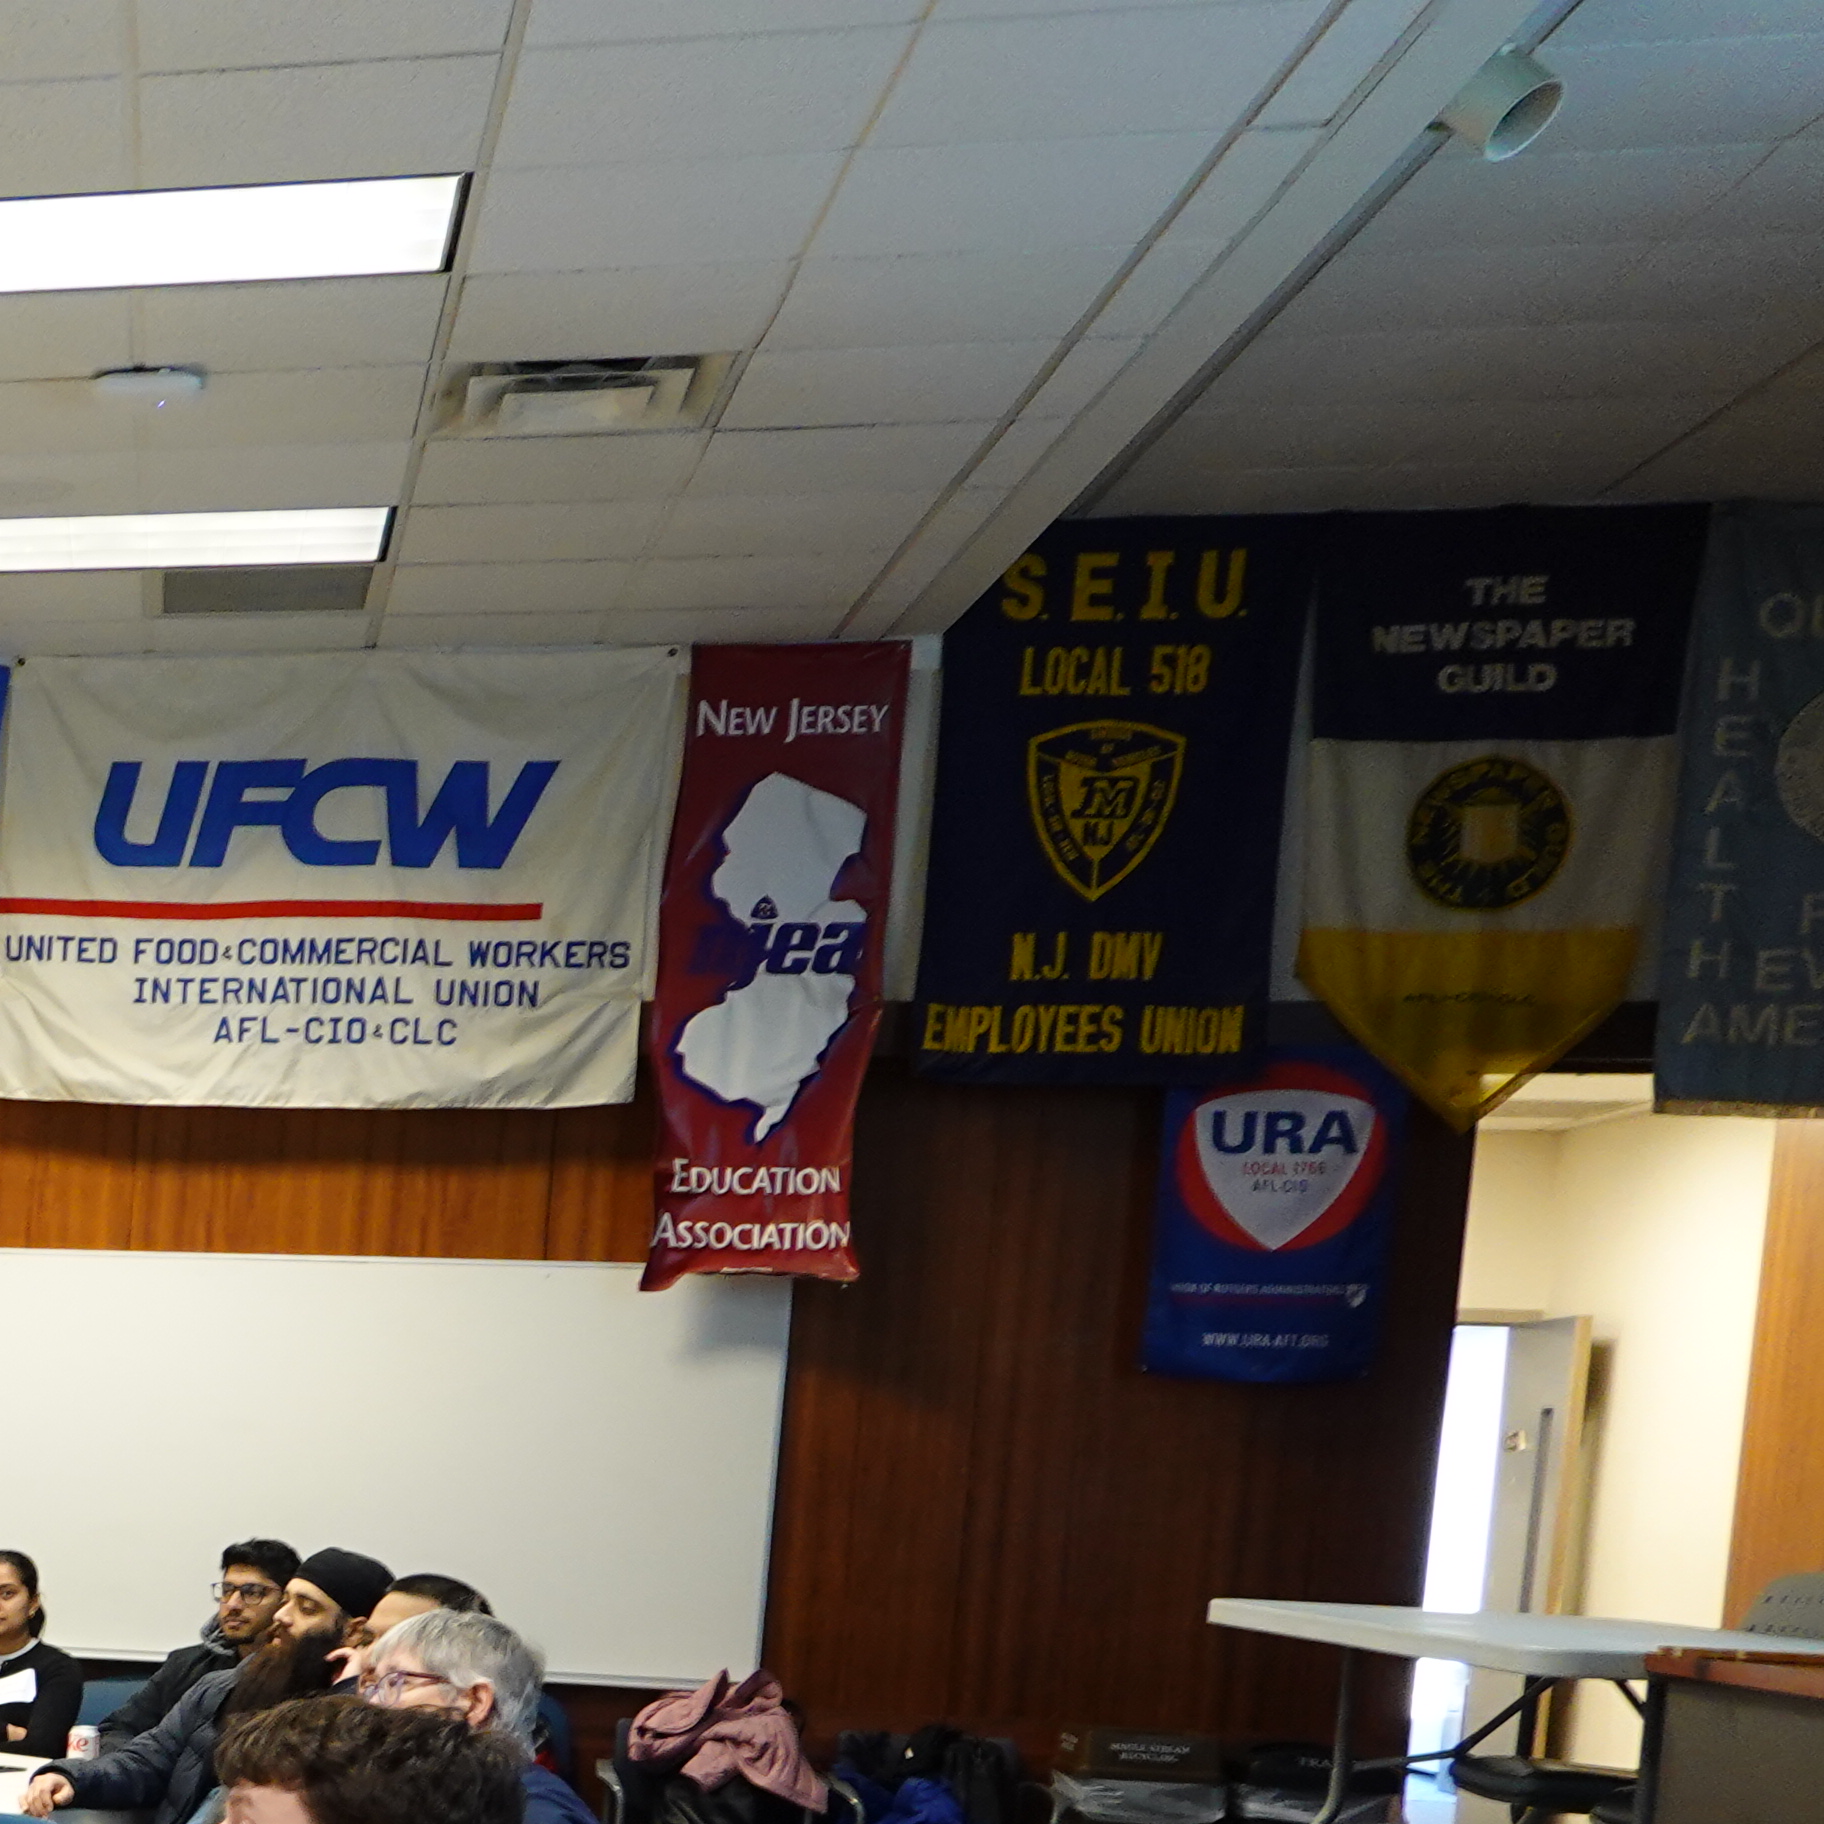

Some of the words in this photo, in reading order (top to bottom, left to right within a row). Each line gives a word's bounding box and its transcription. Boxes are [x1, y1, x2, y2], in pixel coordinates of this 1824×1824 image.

[1466, 575, 1549, 605] THE
[1371, 617, 1636, 655] NEWSPAPER
[1019, 647, 1131, 696] LOCAL
[1152, 644, 1212, 693] 518
[1438, 663, 1556, 694] GUILD
[697, 699, 778, 738] NEW
[785, 697, 890, 744] JERSEY
[94, 758, 561, 870] UFCW
[5, 935, 118, 965] UNITED
[468, 938, 632, 969] WORKERS
[1009, 932, 1069, 982] N.J.
[1089, 930, 1164, 981] DMV
[132, 976, 414, 1006] INTERNATIONAL
[435, 978, 540, 1008] UNION
[921, 1004, 1124, 1054] EMPLOYEES
[1140, 1004, 1245, 1055] UNION
[1211, 1108, 1358, 1155] URA
[670, 1157, 842, 1196] EDUCATION
[1242, 1161, 1287, 1176] LOCAL
[652, 1212, 851, 1251] ASSOCIATION
